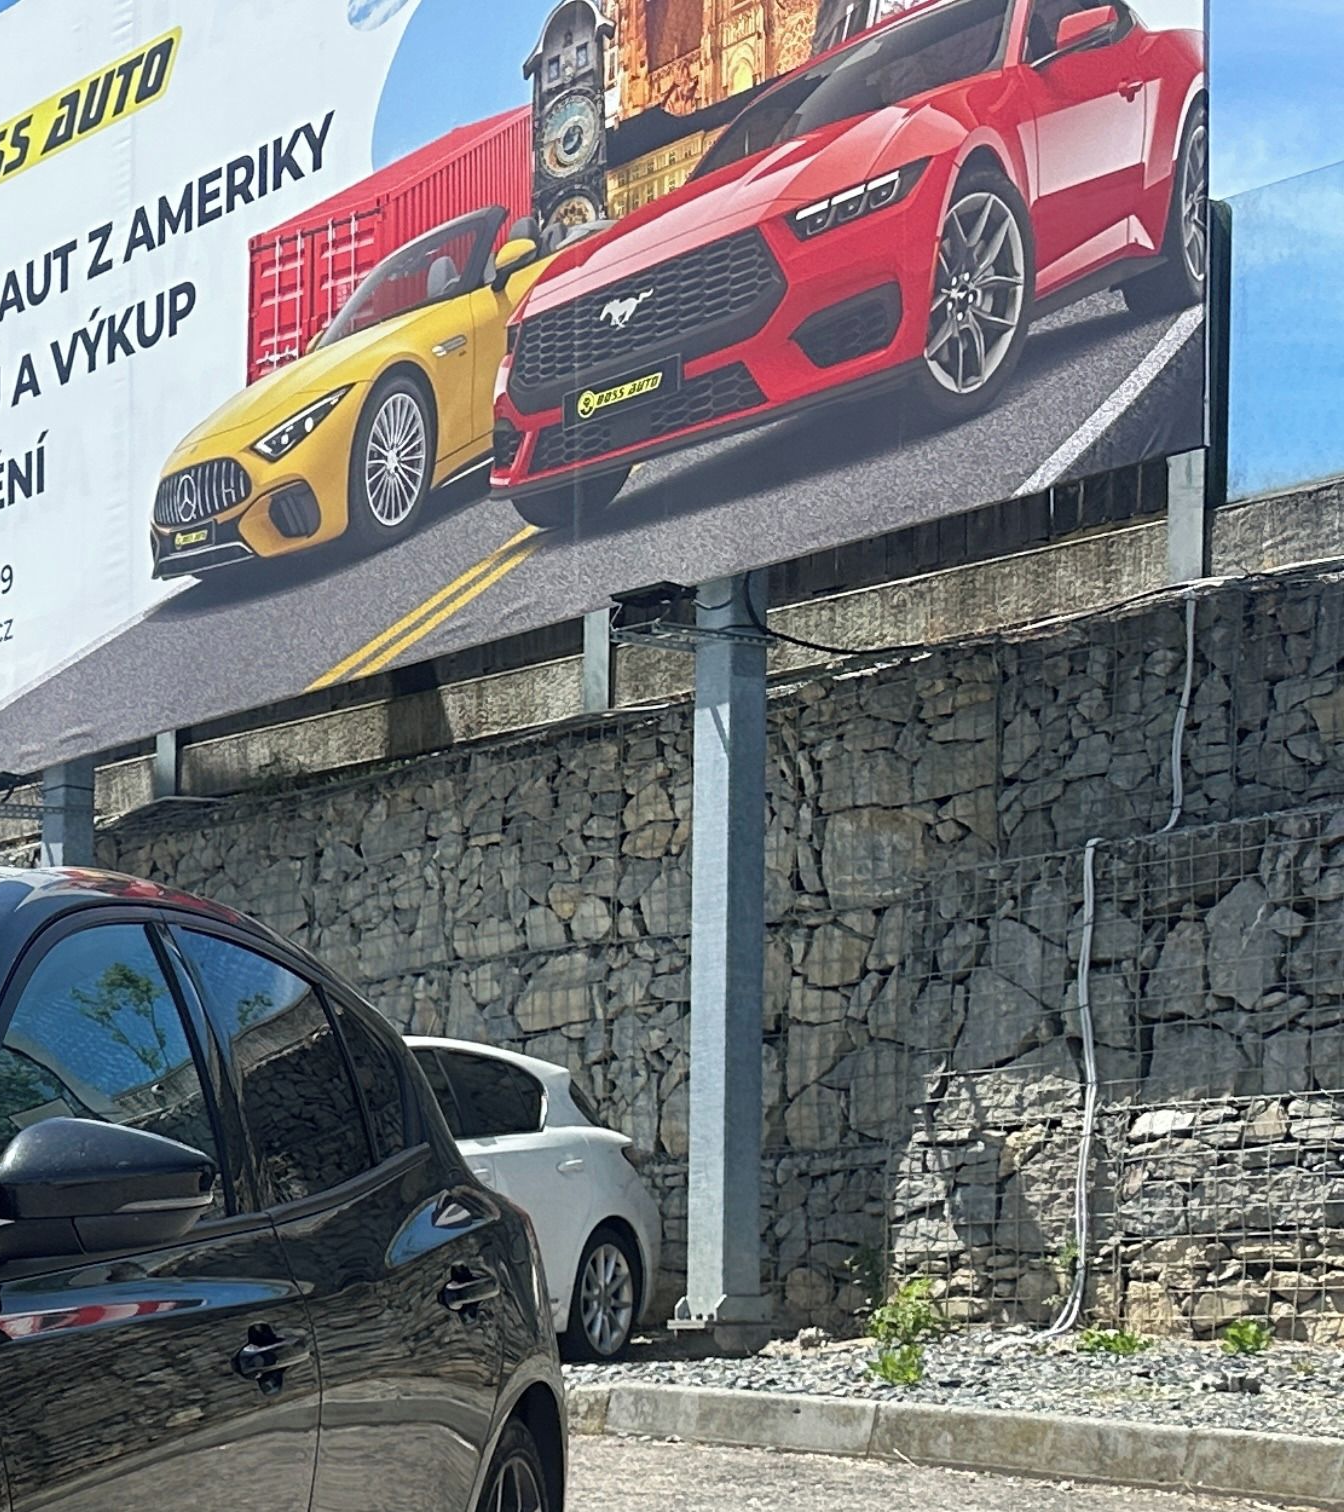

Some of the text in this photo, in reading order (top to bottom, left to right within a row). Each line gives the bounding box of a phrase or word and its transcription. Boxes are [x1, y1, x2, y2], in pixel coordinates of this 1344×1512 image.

[40, 34, 177, 158] AUTO
[87, 227, 115, 280] Z
[123, 110, 336, 263] AMERIKY
[12, 354, 42, 407] A
[50, 281, 198, 386] VÝKUP
[596, 376, 659, 405] BOSS AUTO
